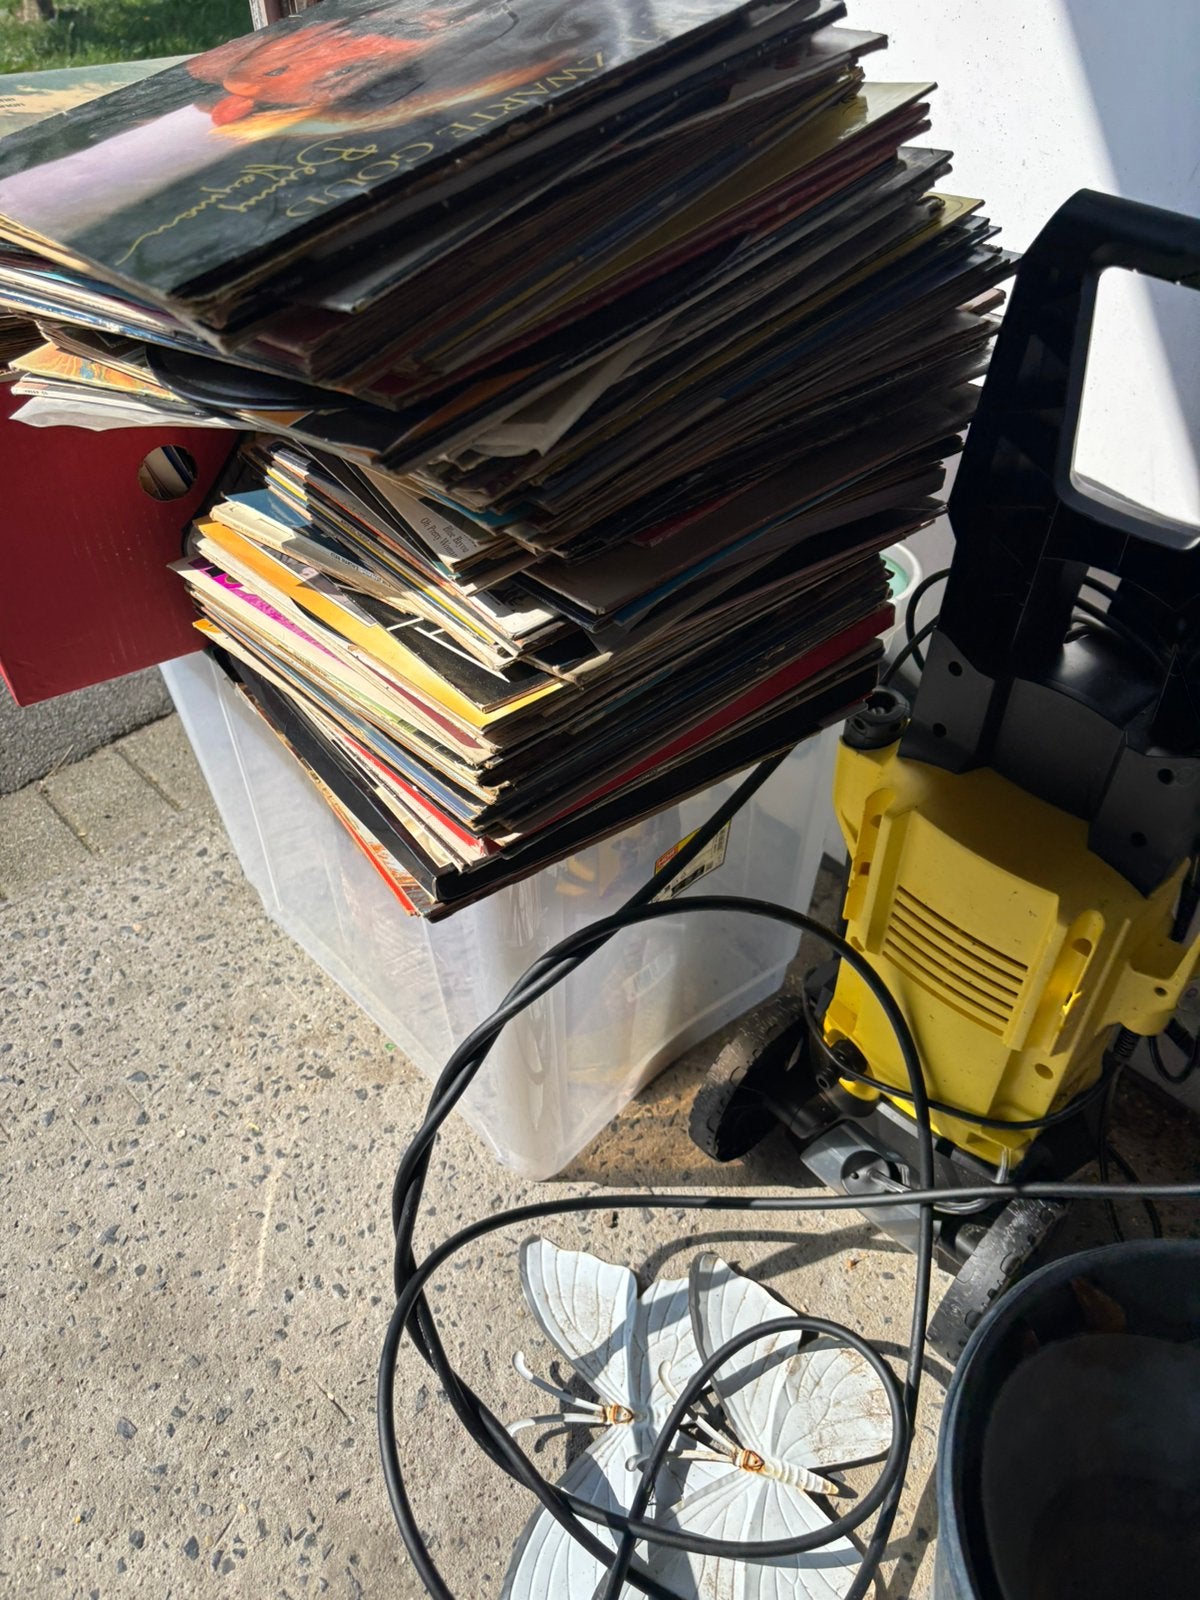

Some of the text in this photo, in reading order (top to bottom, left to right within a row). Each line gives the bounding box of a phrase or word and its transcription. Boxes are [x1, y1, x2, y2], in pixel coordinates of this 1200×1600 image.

[286, 52, 604, 218] ZWARTE GOUD
[218, 137, 379, 213] Benny
[420, 517, 432, 528] Oh
